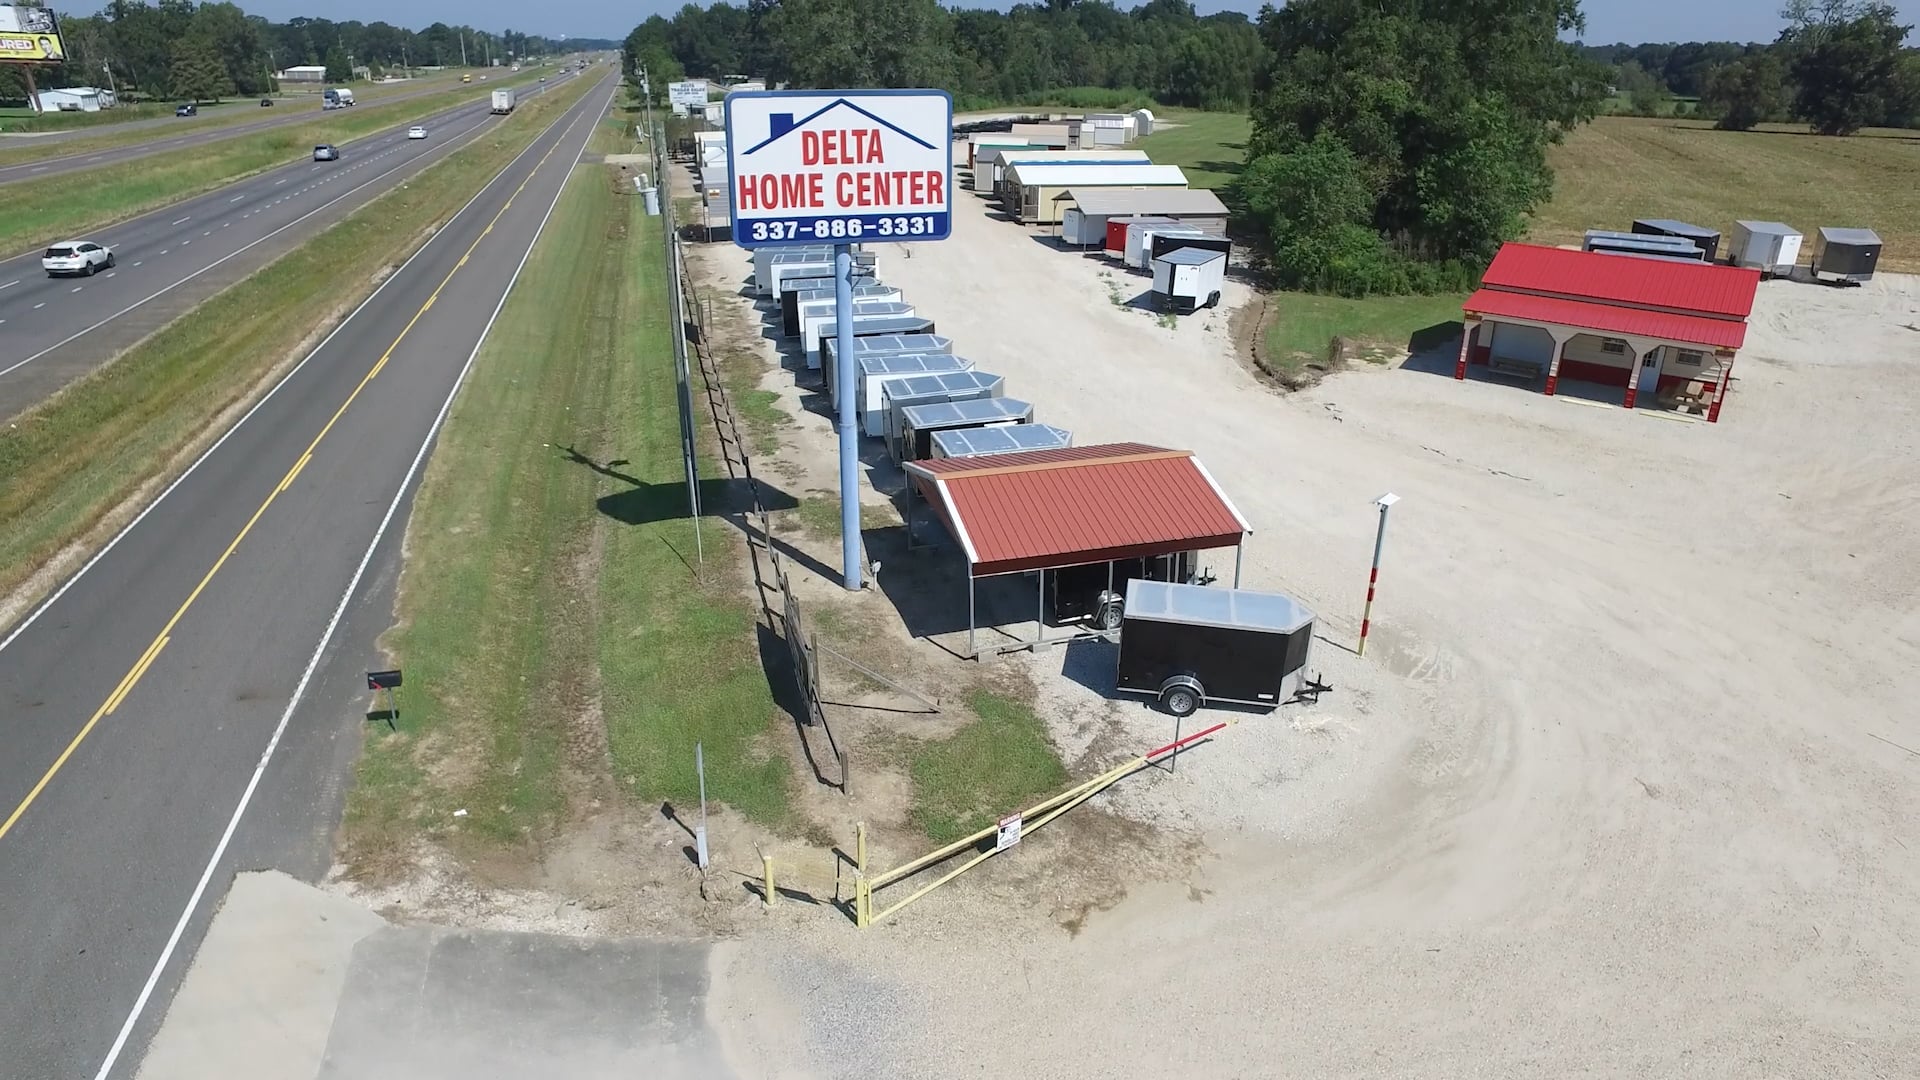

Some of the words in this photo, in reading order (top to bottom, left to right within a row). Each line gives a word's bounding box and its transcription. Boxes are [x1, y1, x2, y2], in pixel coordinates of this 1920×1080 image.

[802, 128, 884, 165] DELTA
[738, 173, 824, 210] HOME
[836, 170, 944, 208] CENTER
[752, 216, 934, 240] 337-886-3331
